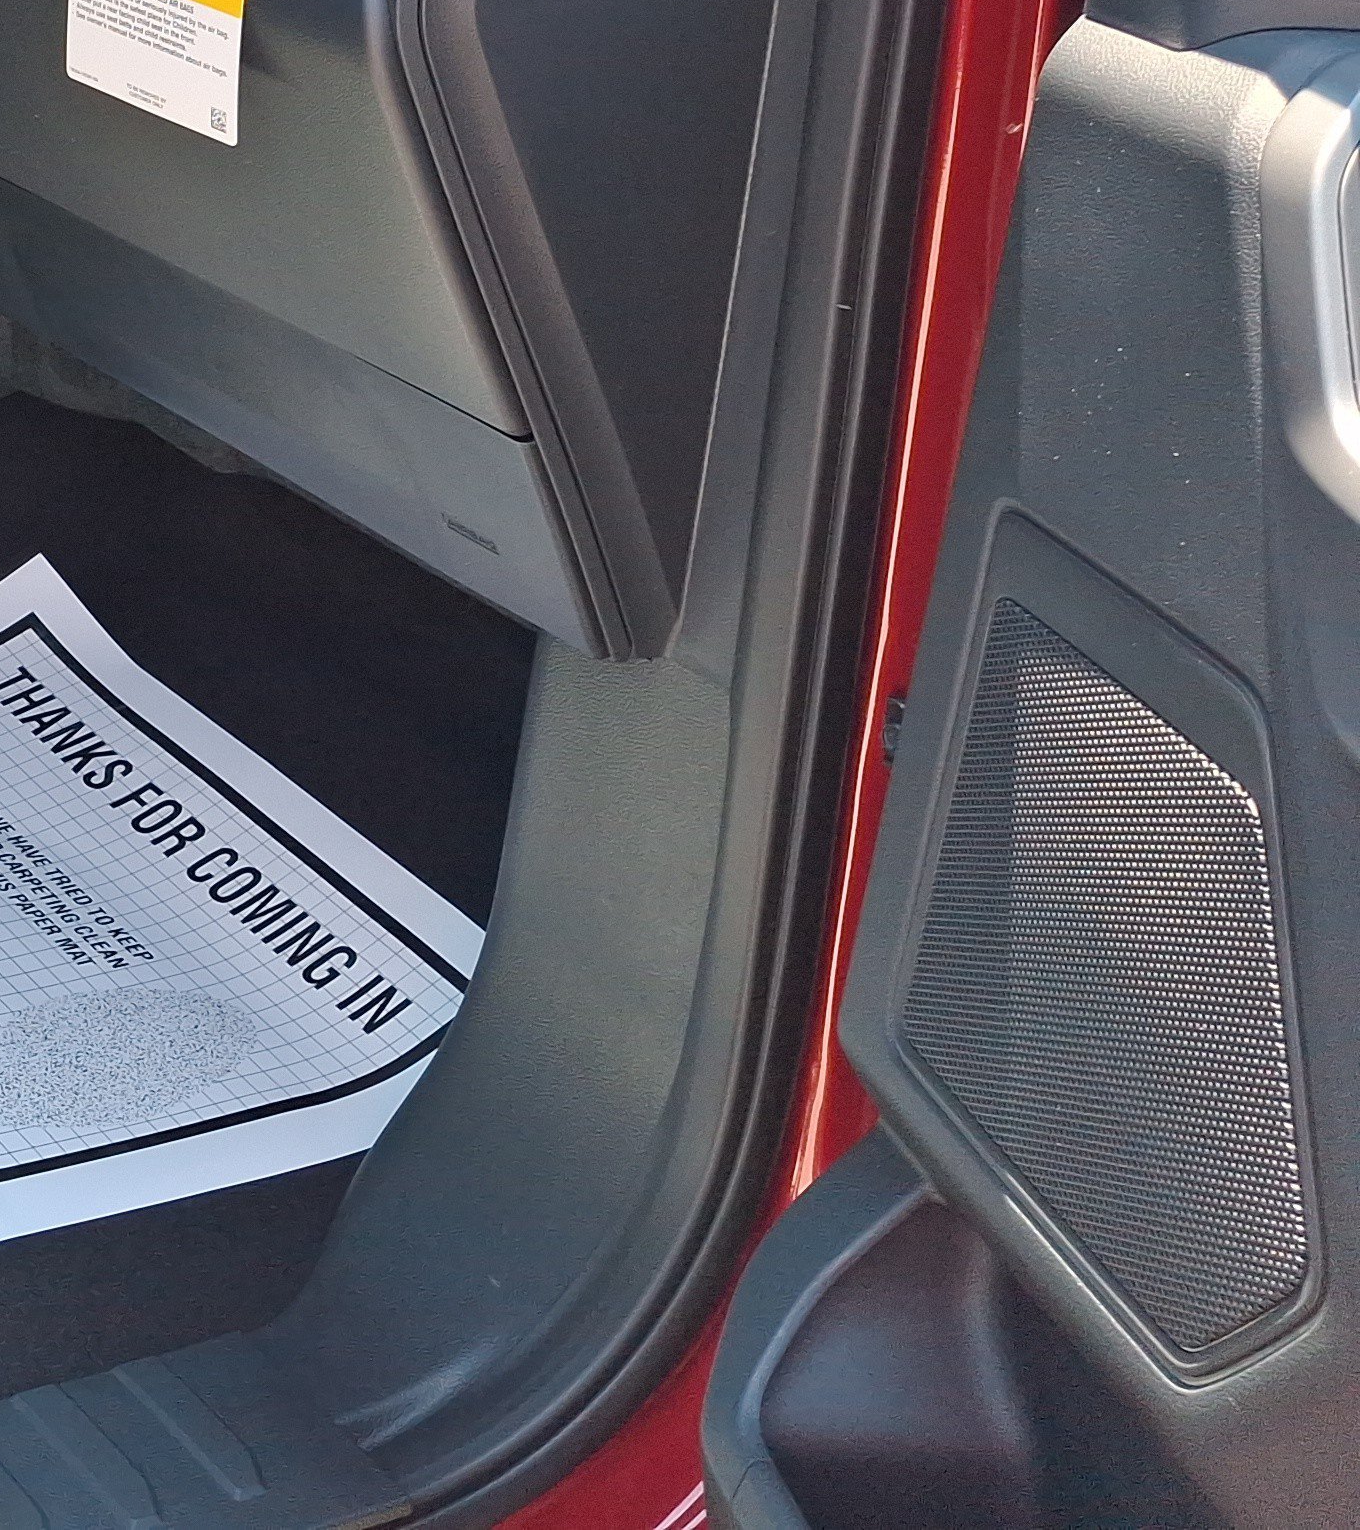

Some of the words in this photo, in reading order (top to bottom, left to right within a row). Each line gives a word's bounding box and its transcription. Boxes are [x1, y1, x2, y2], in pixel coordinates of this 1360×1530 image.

[7, 835, 52, 867] HAVE
[45, 868, 93, 906] TRIED
[88, 907, 114, 925] TO
[107, 928, 154, 961] KEEP
[9, 894, 62, 935] PAPER
[55, 939, 96, 966] MAT
[74, 926, 129, 969] CLEAN
[110, 782, 205, 858] FOR
[187, 847, 357, 990] COMING
[335, 974, 412, 1035] IN
